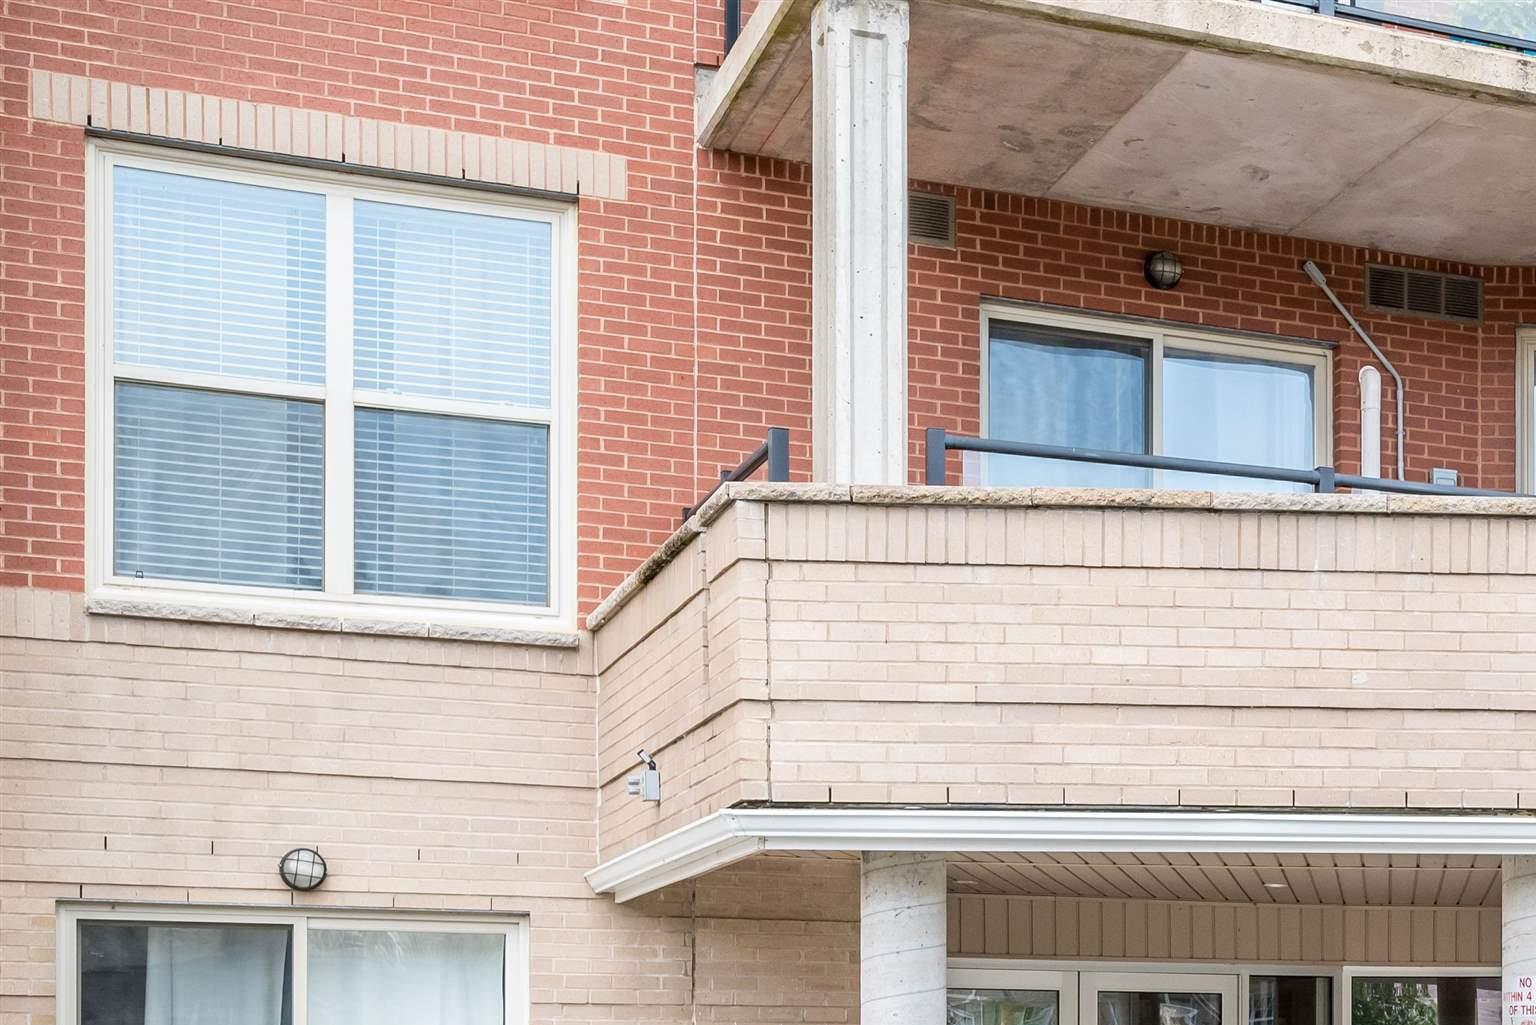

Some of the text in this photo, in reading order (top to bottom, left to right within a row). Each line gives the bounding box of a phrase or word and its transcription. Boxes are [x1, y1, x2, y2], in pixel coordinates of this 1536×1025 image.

[1519, 977, 1532, 988] NO
[1526, 991, 1532, 1001] 4
[1508, 1005, 1518, 1016] OF
